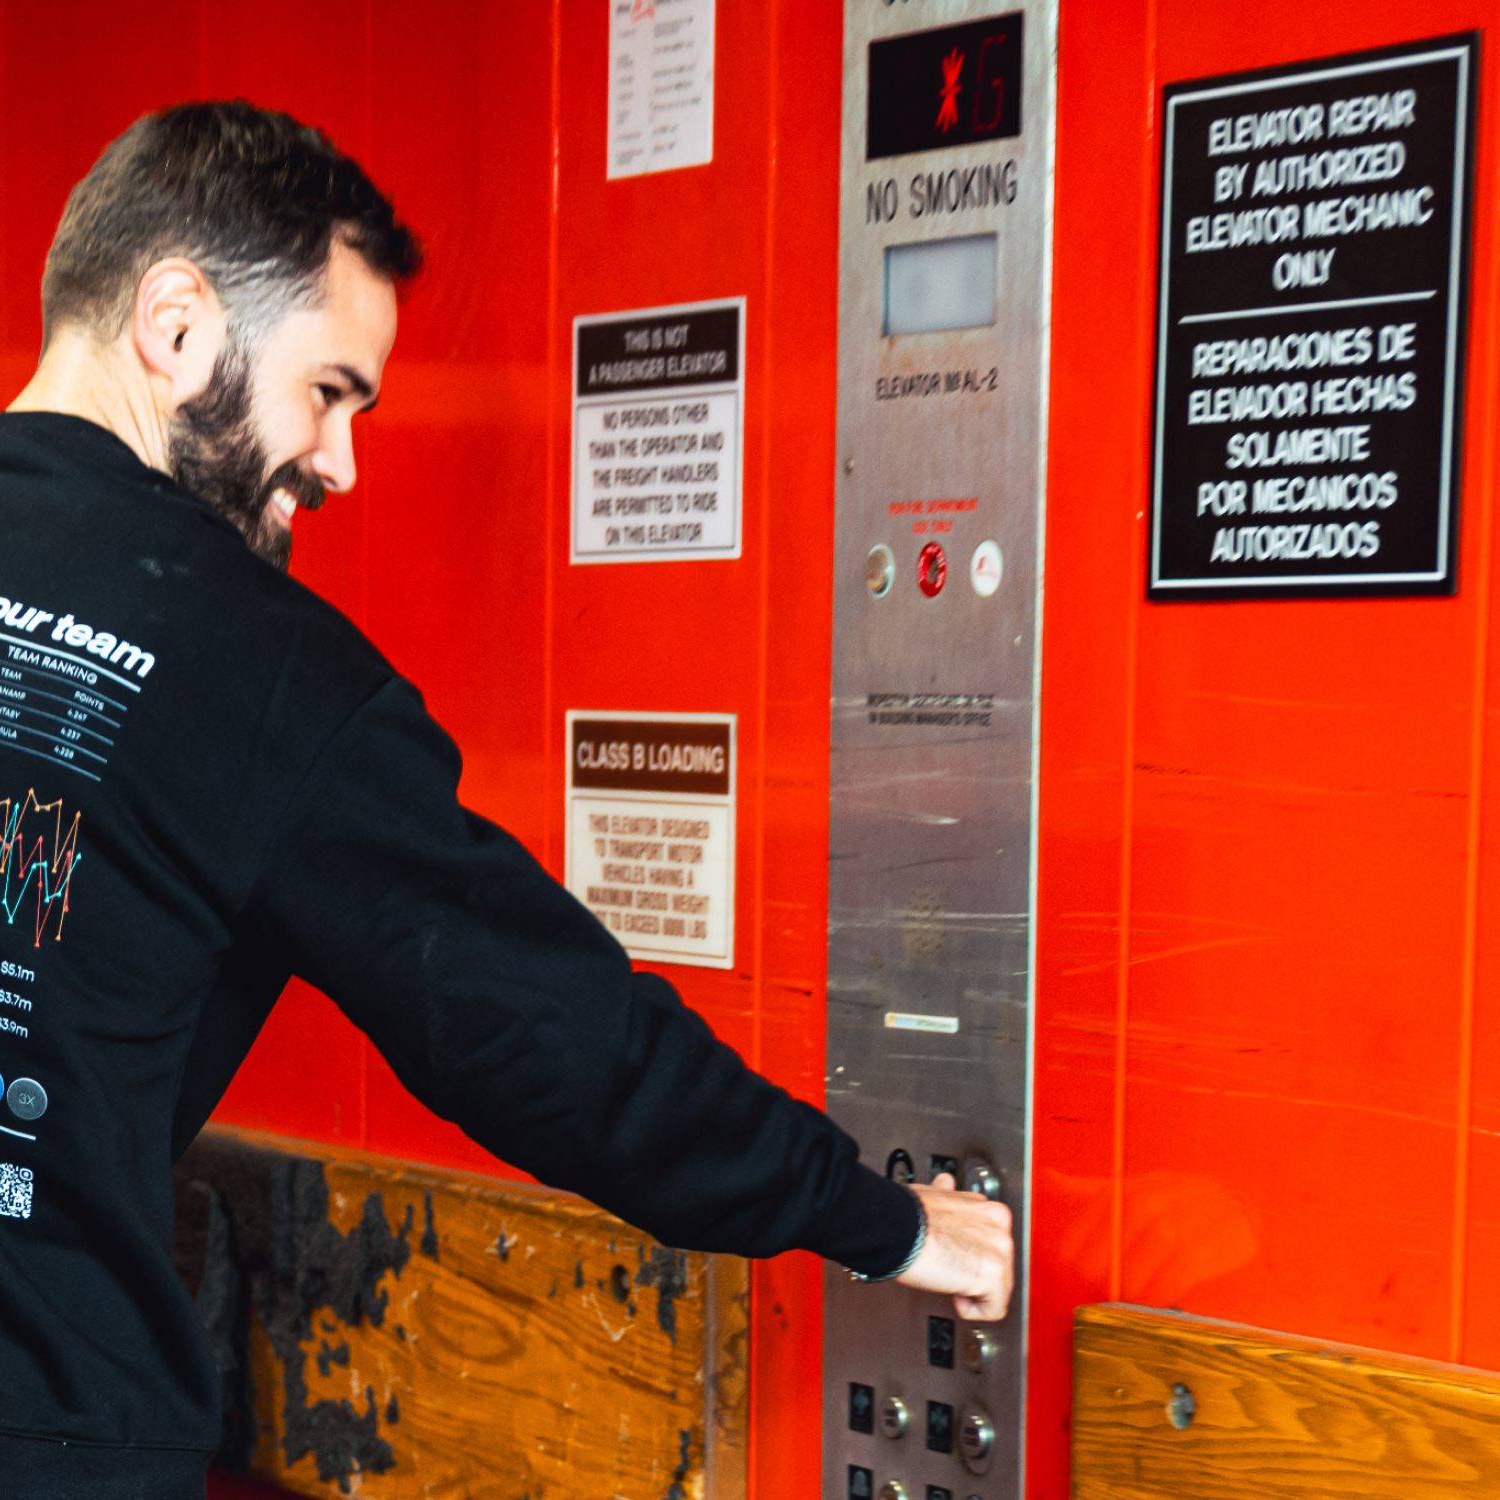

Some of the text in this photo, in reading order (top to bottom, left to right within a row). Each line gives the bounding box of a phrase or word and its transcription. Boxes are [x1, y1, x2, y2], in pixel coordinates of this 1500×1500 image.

[1208, 89, 1417, 157] ELEVATOR REPAIR
[866, 158, 1018, 226] NO SMOKING
[1214, 141, 1407, 203] BY AUTHORIZED
[1186, 185, 1434, 254] ELEVATOR MECHANIC
[1272, 247, 1337, 291] ONLY
[624, 324, 690, 353] THIS IS NOT
[1191, 322, 1417, 379] REPARACIONES DE
[588, 350, 727, 386] A PASSENGER ELEVATOR
[875, 371, 940, 401] ELEVATOR
[603, 402, 709, 430] NO PERSONS OTHER
[1188, 371, 1417, 426] ELEVADOR HECHAS
[588, 431, 724, 460] THAN THE OPERATOR AND
[1225, 424, 1371, 470] SOLAMENTE
[593, 461, 718, 488] THE FREIGHT HANDLERS
[1197, 470, 1399, 517] POR MECANICOS
[592, 491, 718, 517] ARE PERMITTED TO RIDE
[605, 522, 702, 545] ON THIS ELEVATOR
[1210, 520, 1380, 563] AUTORIZADOS
[7, 645, 98, 685] TEAM RANKING
[50, 614, 156, 678] team
[1, 667, 22, 681] TEAM
[73, 690, 105, 712] POINTS
[577, 741, 725, 774] CLASS B LOADING
[0, 960, 35, 982] $5.1m
[18, 1093, 36, 1107] 3X
